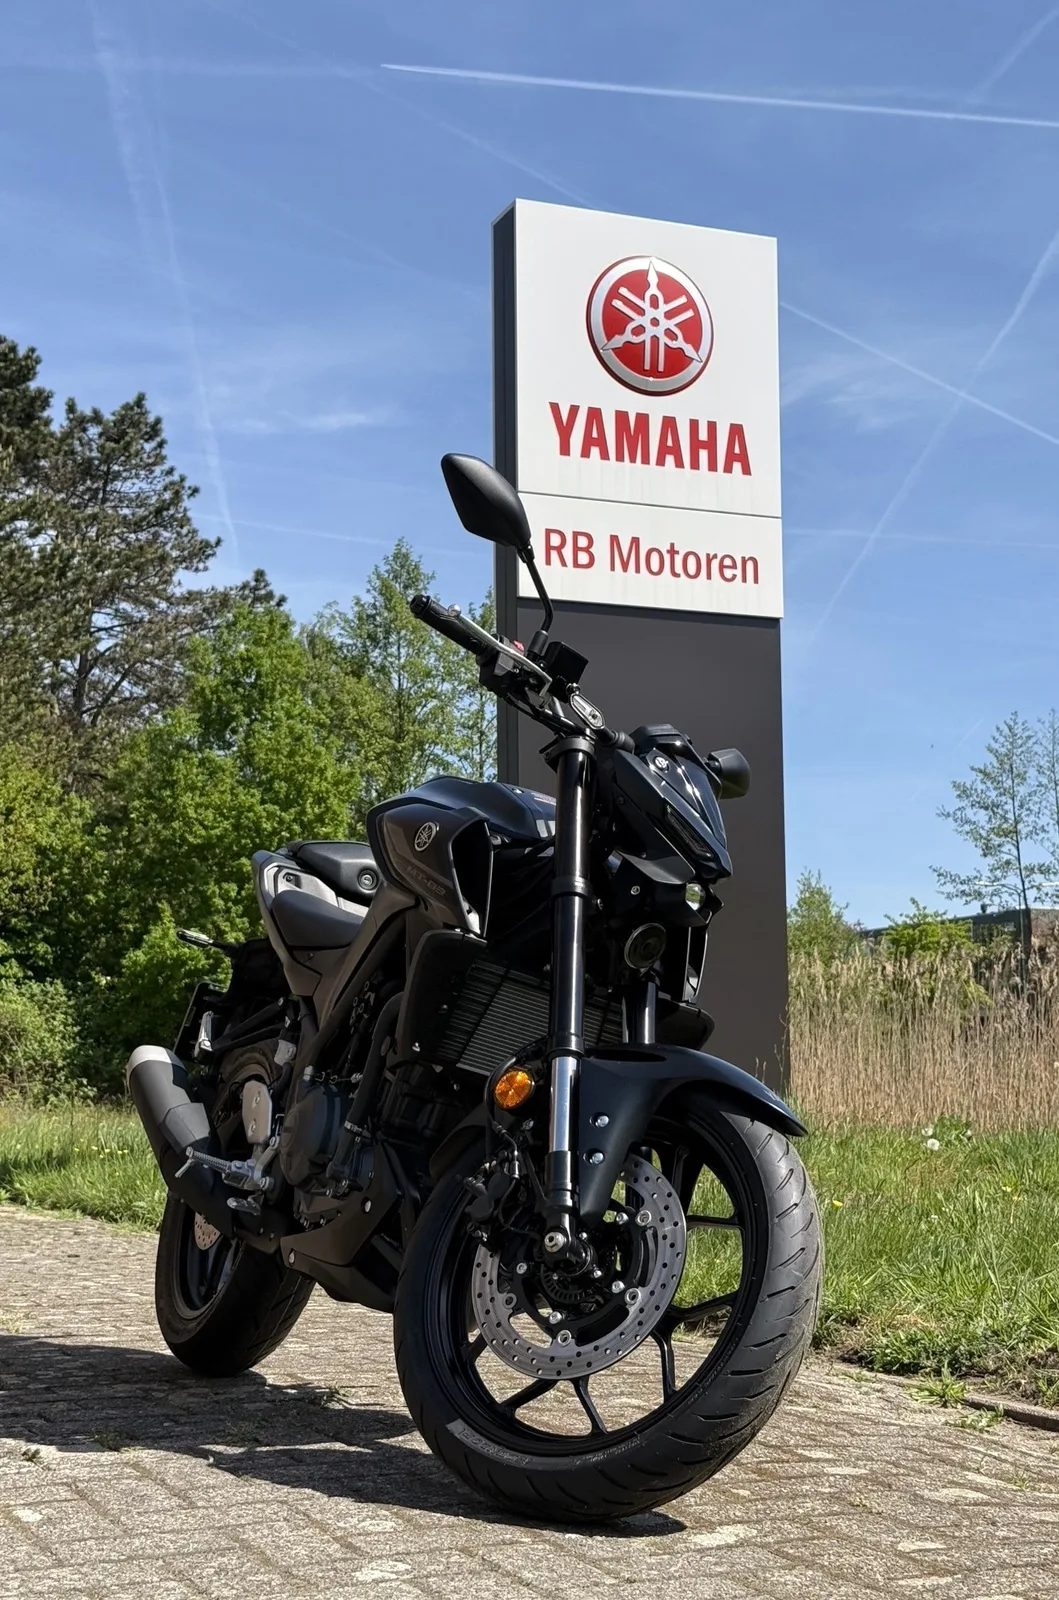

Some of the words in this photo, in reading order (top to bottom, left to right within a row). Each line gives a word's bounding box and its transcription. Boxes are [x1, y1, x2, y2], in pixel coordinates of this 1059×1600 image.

[549, 402, 752, 476] YAMAHA
[544, 528, 596, 570] RB
[609, 534, 759, 584] Motoren
[407, 865, 446, 896] MT-03
